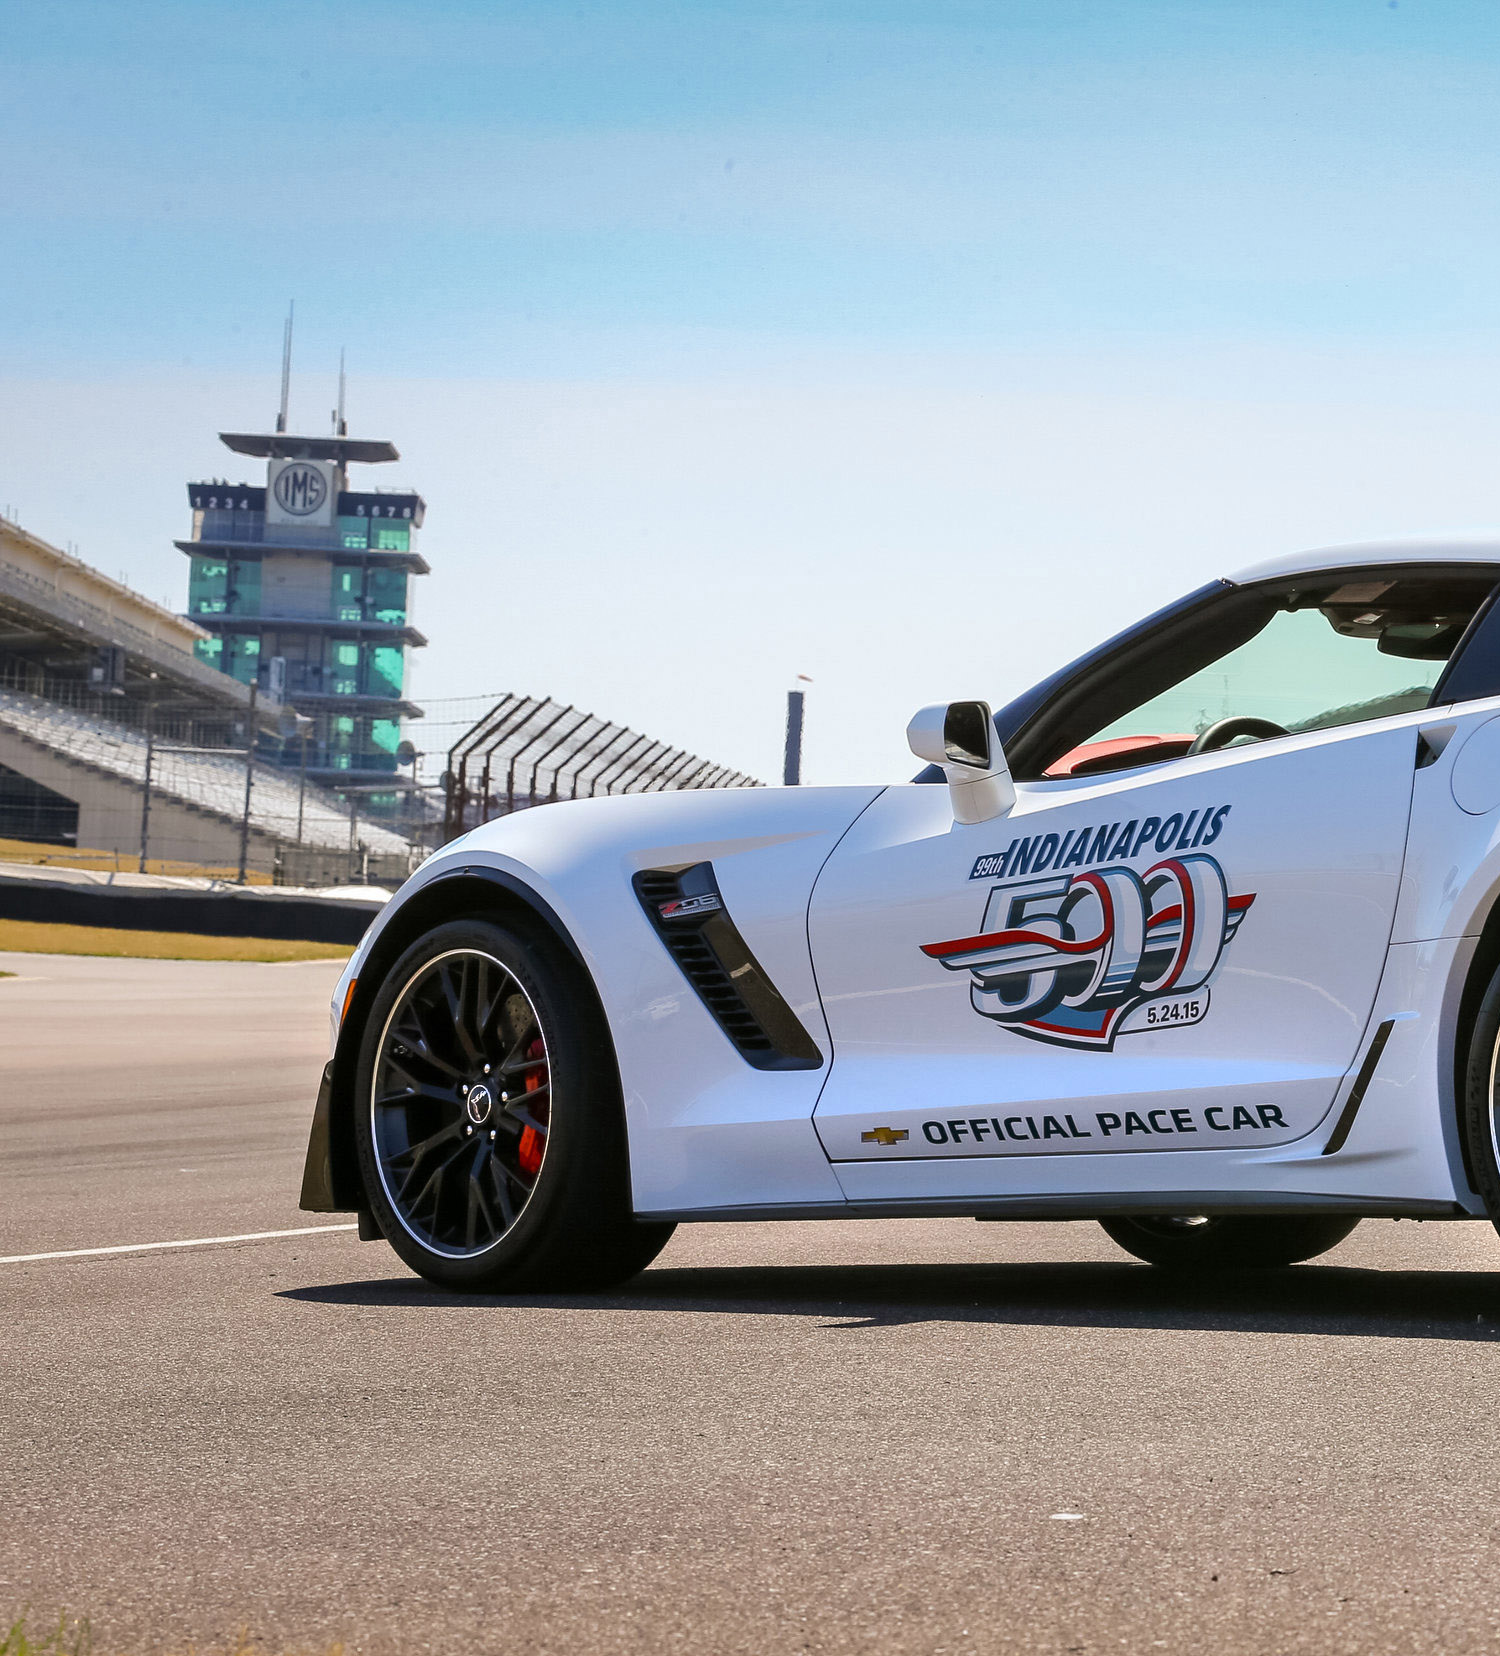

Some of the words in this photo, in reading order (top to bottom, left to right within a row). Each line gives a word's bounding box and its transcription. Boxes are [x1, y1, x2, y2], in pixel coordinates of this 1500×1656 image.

[209, 497, 217, 508] 2
[225, 498, 233, 508] 3
[240, 498, 248, 508] 4
[284, 471, 320, 508] IMS
[356, 505, 365, 516] 5
[371, 505, 380, 516] 6
[387, 507, 395, 518] 7
[402, 507, 411, 519] 8
[973, 855, 1003, 877] 99th
[998, 804, 1233, 879] INDIANAPOLIS
[658, 892, 719, 915] Z06
[969, 852, 1229, 1023] 500
[1147, 1001, 1200, 1024] 5.24.15
[921, 1114, 1092, 1145] OFFICIAL
[1095, 1108, 1198, 1137] PACE
[1203, 1103, 1291, 1132] CAR
